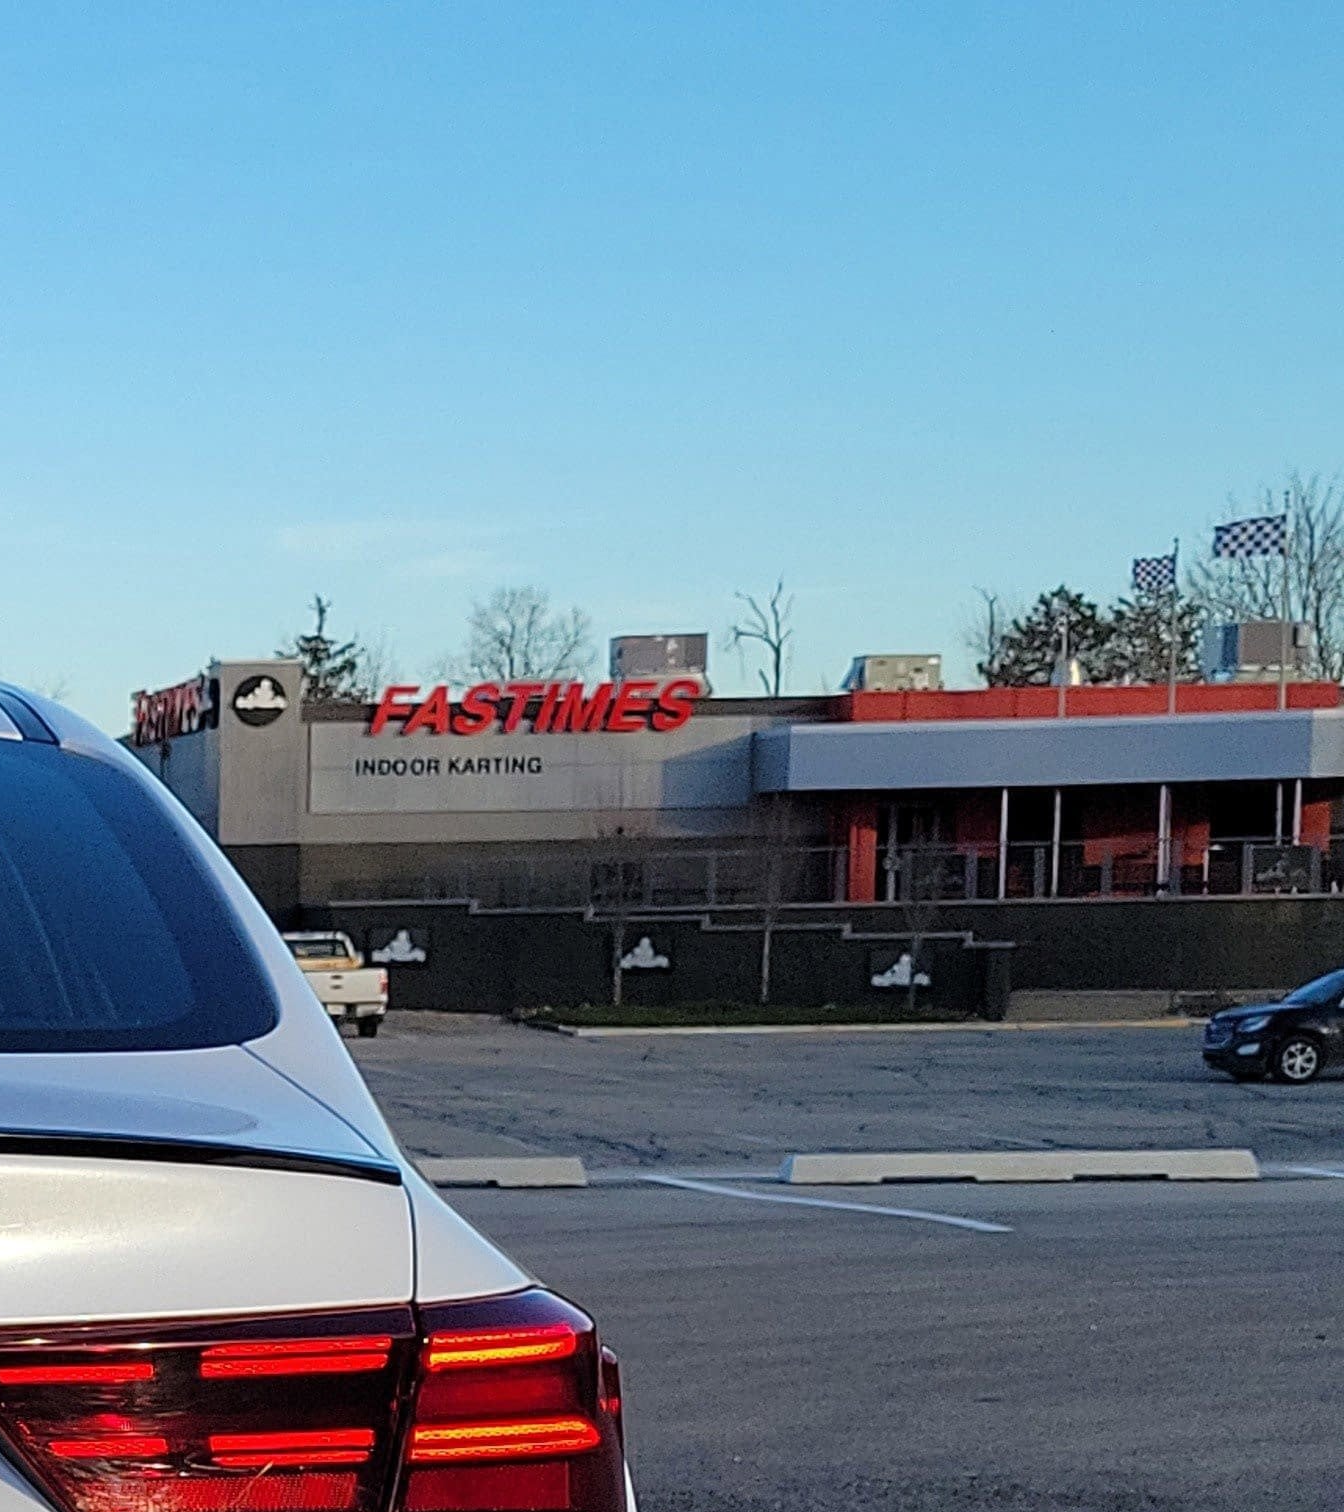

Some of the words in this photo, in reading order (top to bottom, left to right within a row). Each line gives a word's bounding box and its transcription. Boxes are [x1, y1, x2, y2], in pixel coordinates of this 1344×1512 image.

[370, 680, 701, 736] FASTIMES
[355, 757, 440, 776] INDOOR
[448, 756, 543, 775] KARTING
